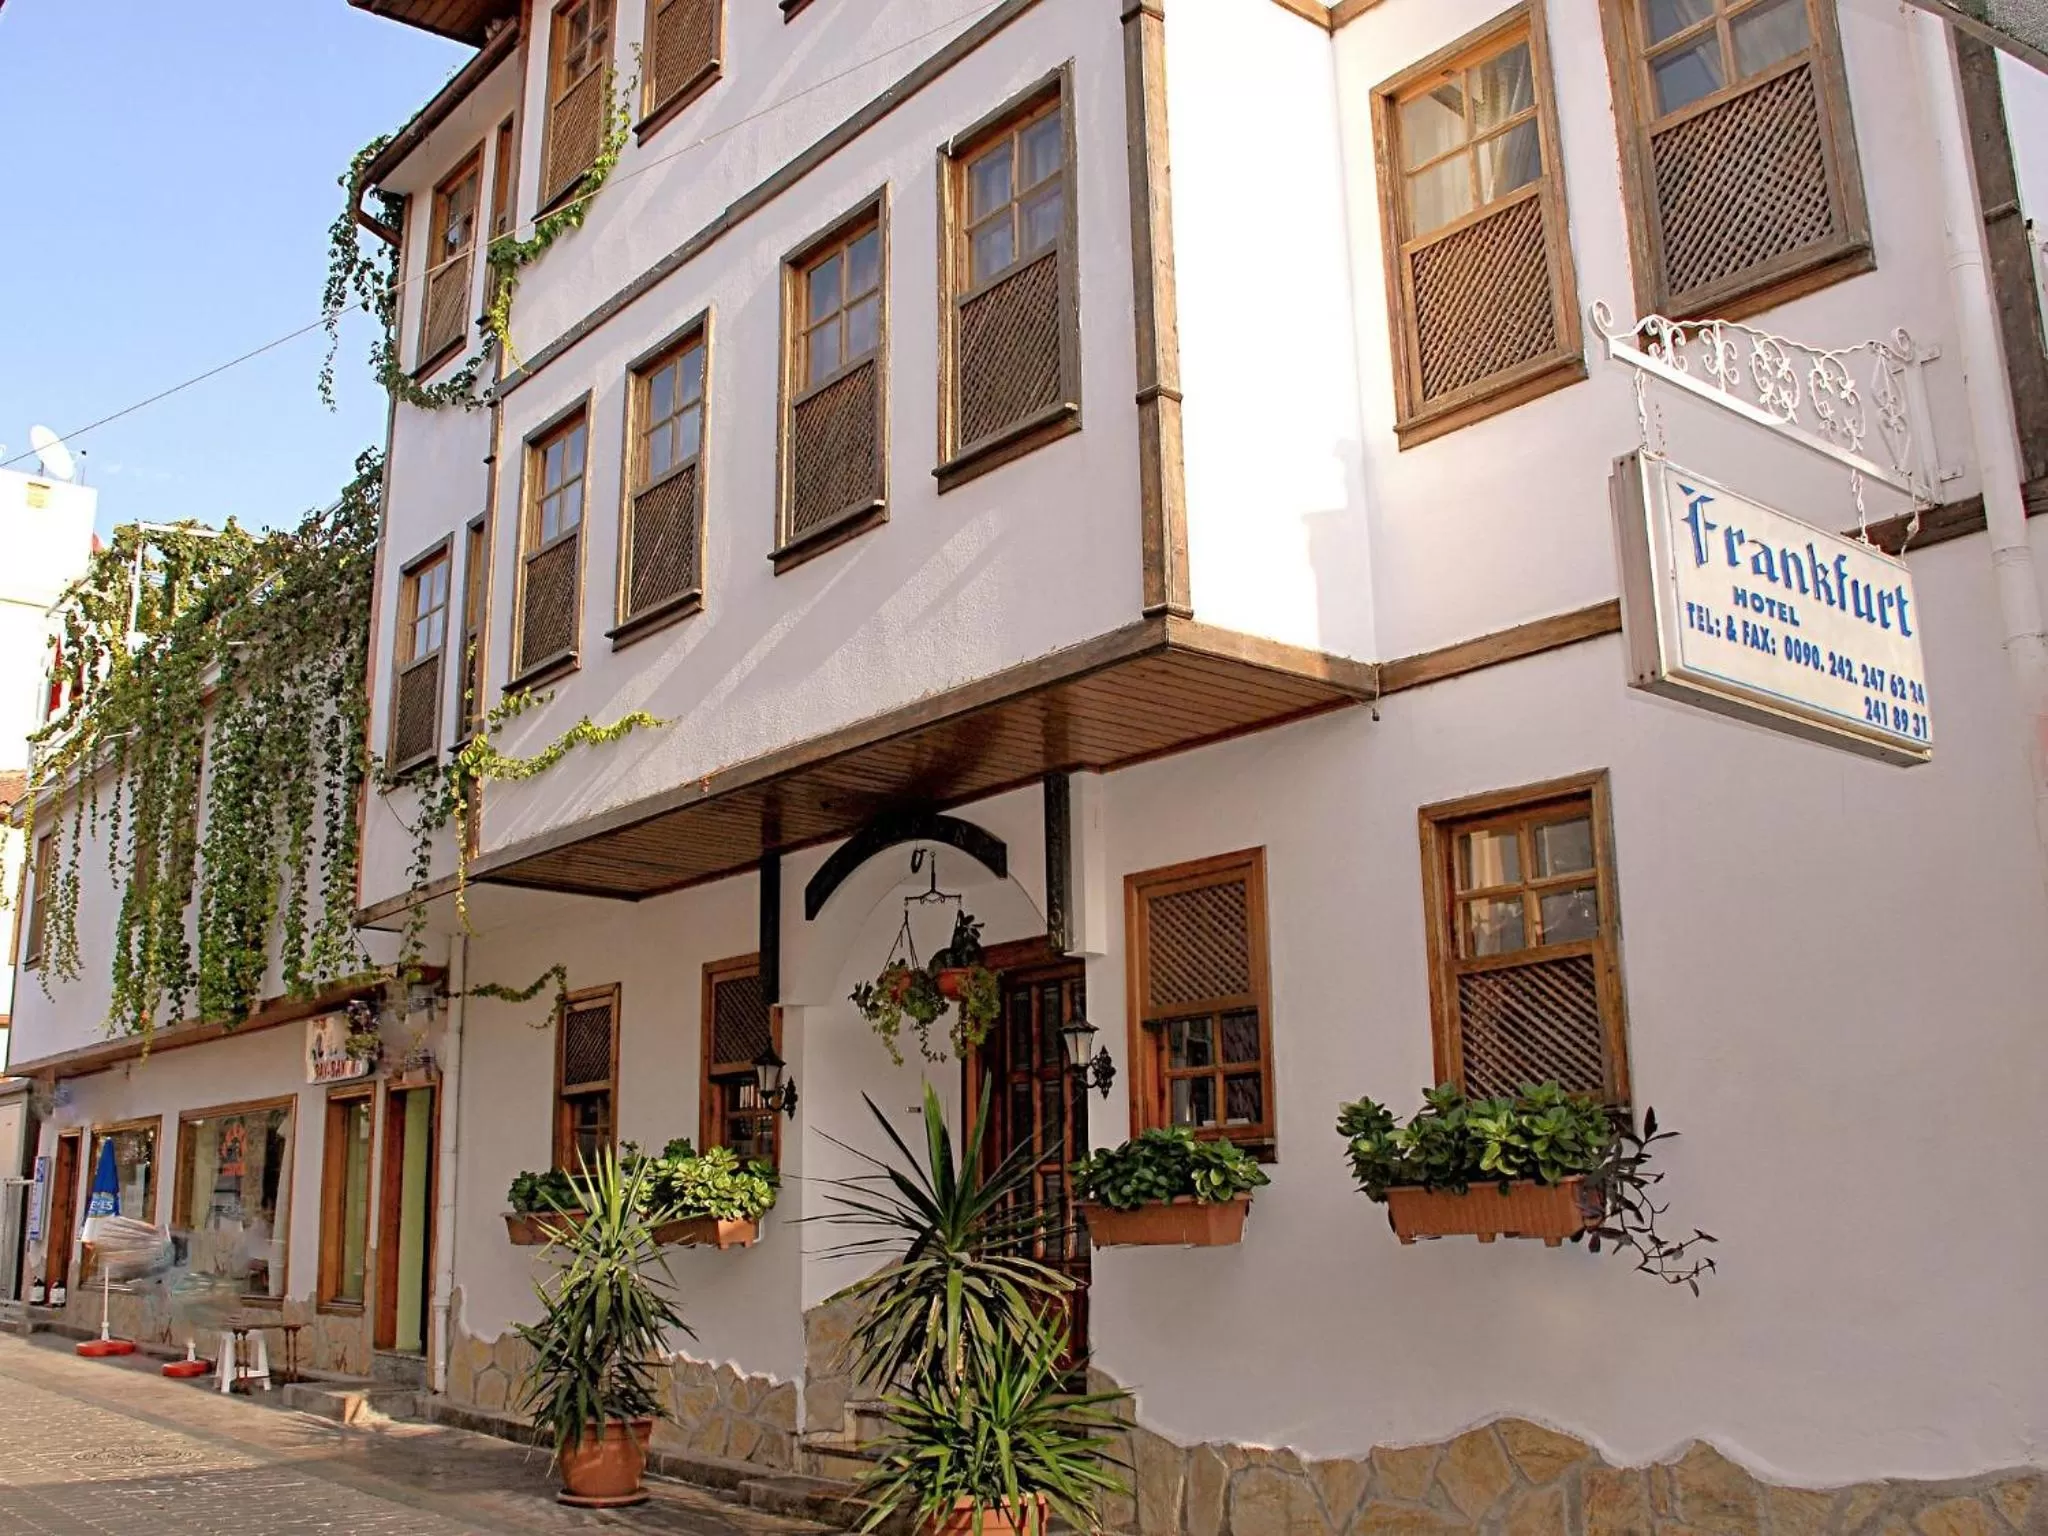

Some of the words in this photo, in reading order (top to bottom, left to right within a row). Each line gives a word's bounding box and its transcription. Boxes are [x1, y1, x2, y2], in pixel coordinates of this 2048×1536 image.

[1677, 483, 1912, 638] Frankfurt
[1734, 586, 1800, 626] HOTEL
[1686, 602, 1721, 637] TEL:
[1726, 616, 1737, 642] &
[1743, 621, 1776, 655] FAX:
[1861, 664, 1885, 691] 247
[1890, 675, 1907, 700] 62
[1864, 698, 1887, 724] 241
[1893, 706, 1908, 731] 89
[1913, 715, 1927, 739] 31
